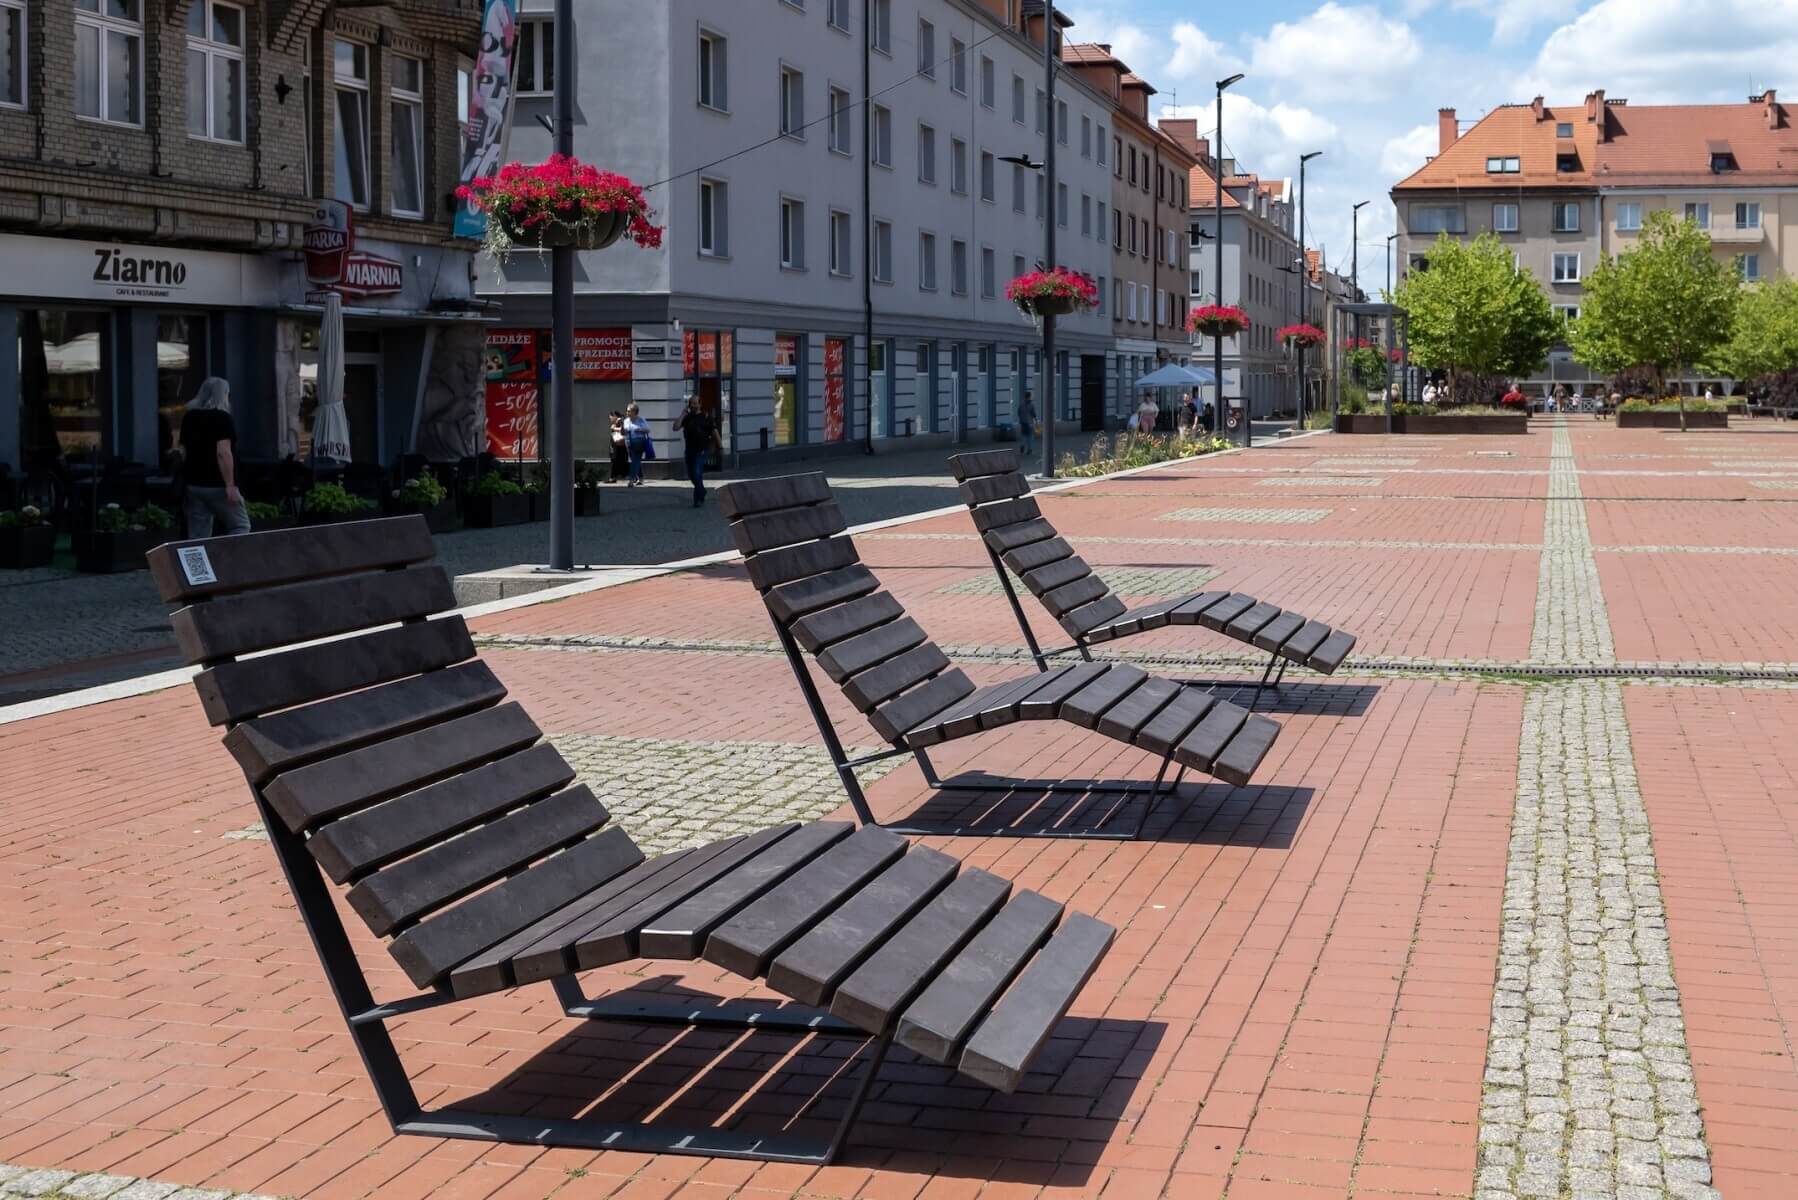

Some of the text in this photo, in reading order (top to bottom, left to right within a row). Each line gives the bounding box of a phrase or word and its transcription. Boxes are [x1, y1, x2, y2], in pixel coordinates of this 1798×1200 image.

[93, 248, 186, 285] Ziarno
[574, 337, 632, 347] PROMOCJE
[603, 361, 631, 370] CENY
[495, 389, 538, 411] -50%
